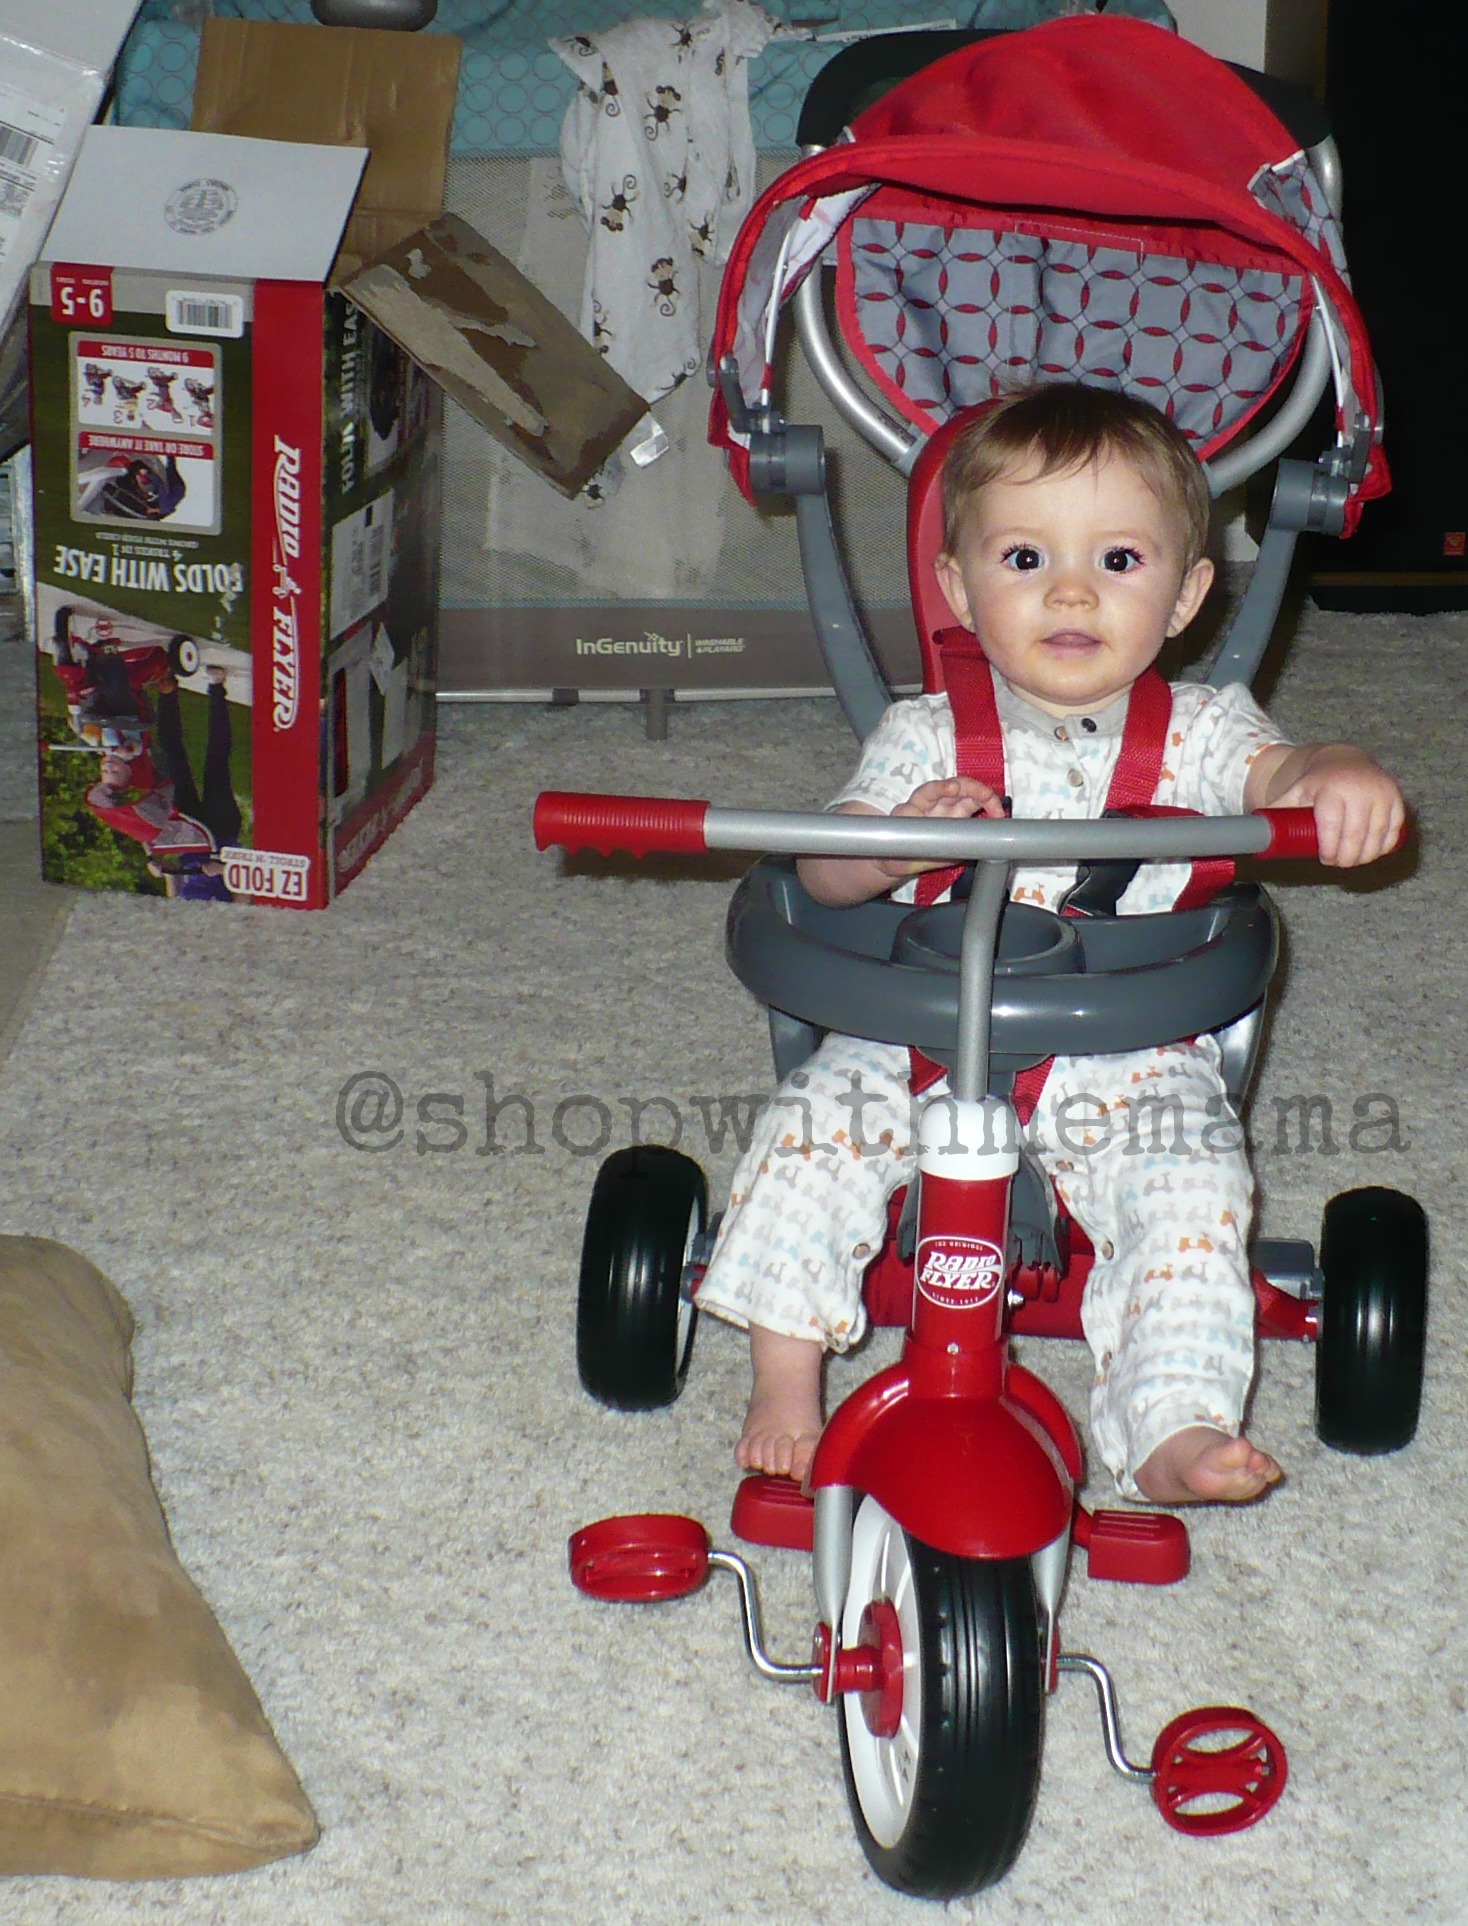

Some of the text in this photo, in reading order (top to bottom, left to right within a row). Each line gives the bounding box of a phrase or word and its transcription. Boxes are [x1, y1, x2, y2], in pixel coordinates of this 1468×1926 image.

[60, 286, 105, 318] 9-5
[341, 302, 360, 346] EAS
[101, 345, 128, 358] YEARS
[340, 351, 361, 419] WITH
[113, 410, 123, 424] 3
[53, 545, 244, 593] FOLDS WITH EASE
[273, 434, 300, 729] RADIO FLYER
[228, 863, 303, 897] EZ FOLD
[924, 1251, 997, 1272] RADIO
[919, 1267, 993, 1290] FLYER
